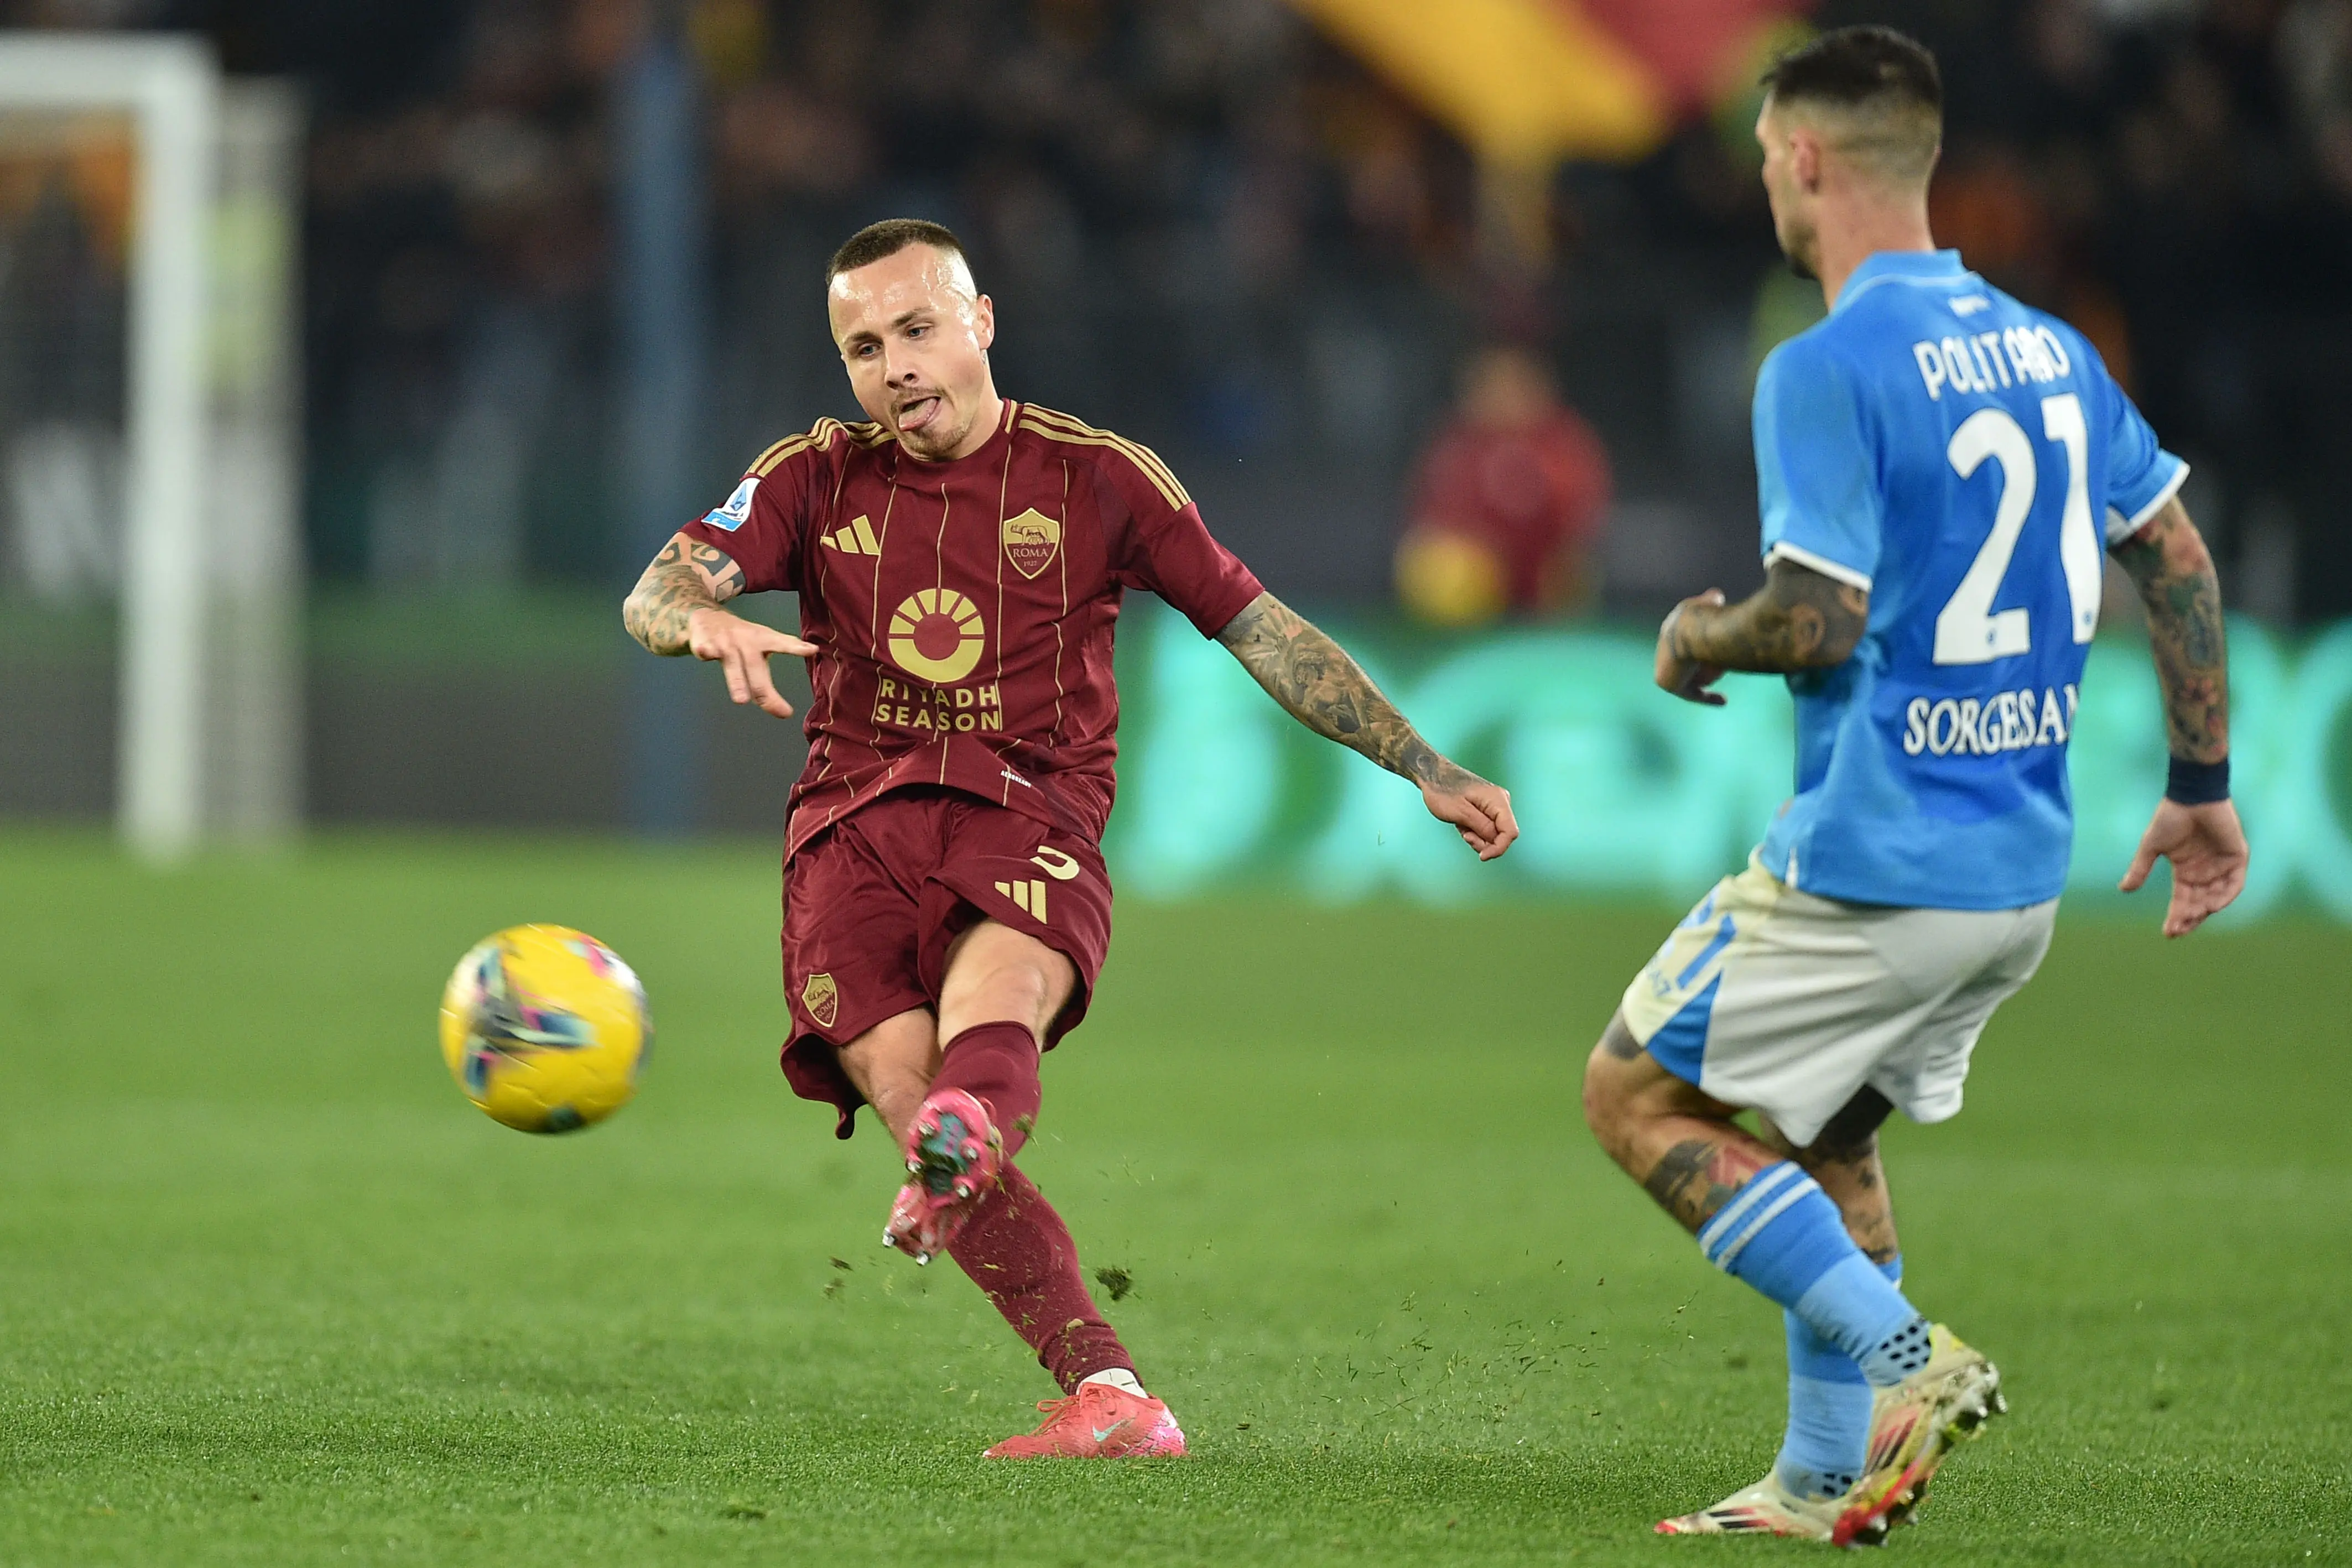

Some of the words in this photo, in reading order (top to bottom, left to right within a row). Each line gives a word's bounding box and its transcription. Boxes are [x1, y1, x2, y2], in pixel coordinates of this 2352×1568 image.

[1932, 392, 2103, 665] 21
[1013, 548, 1048, 558] ROMA
[881, 679, 998, 708] RIYADH
[875, 704, 999, 732] SEASON
